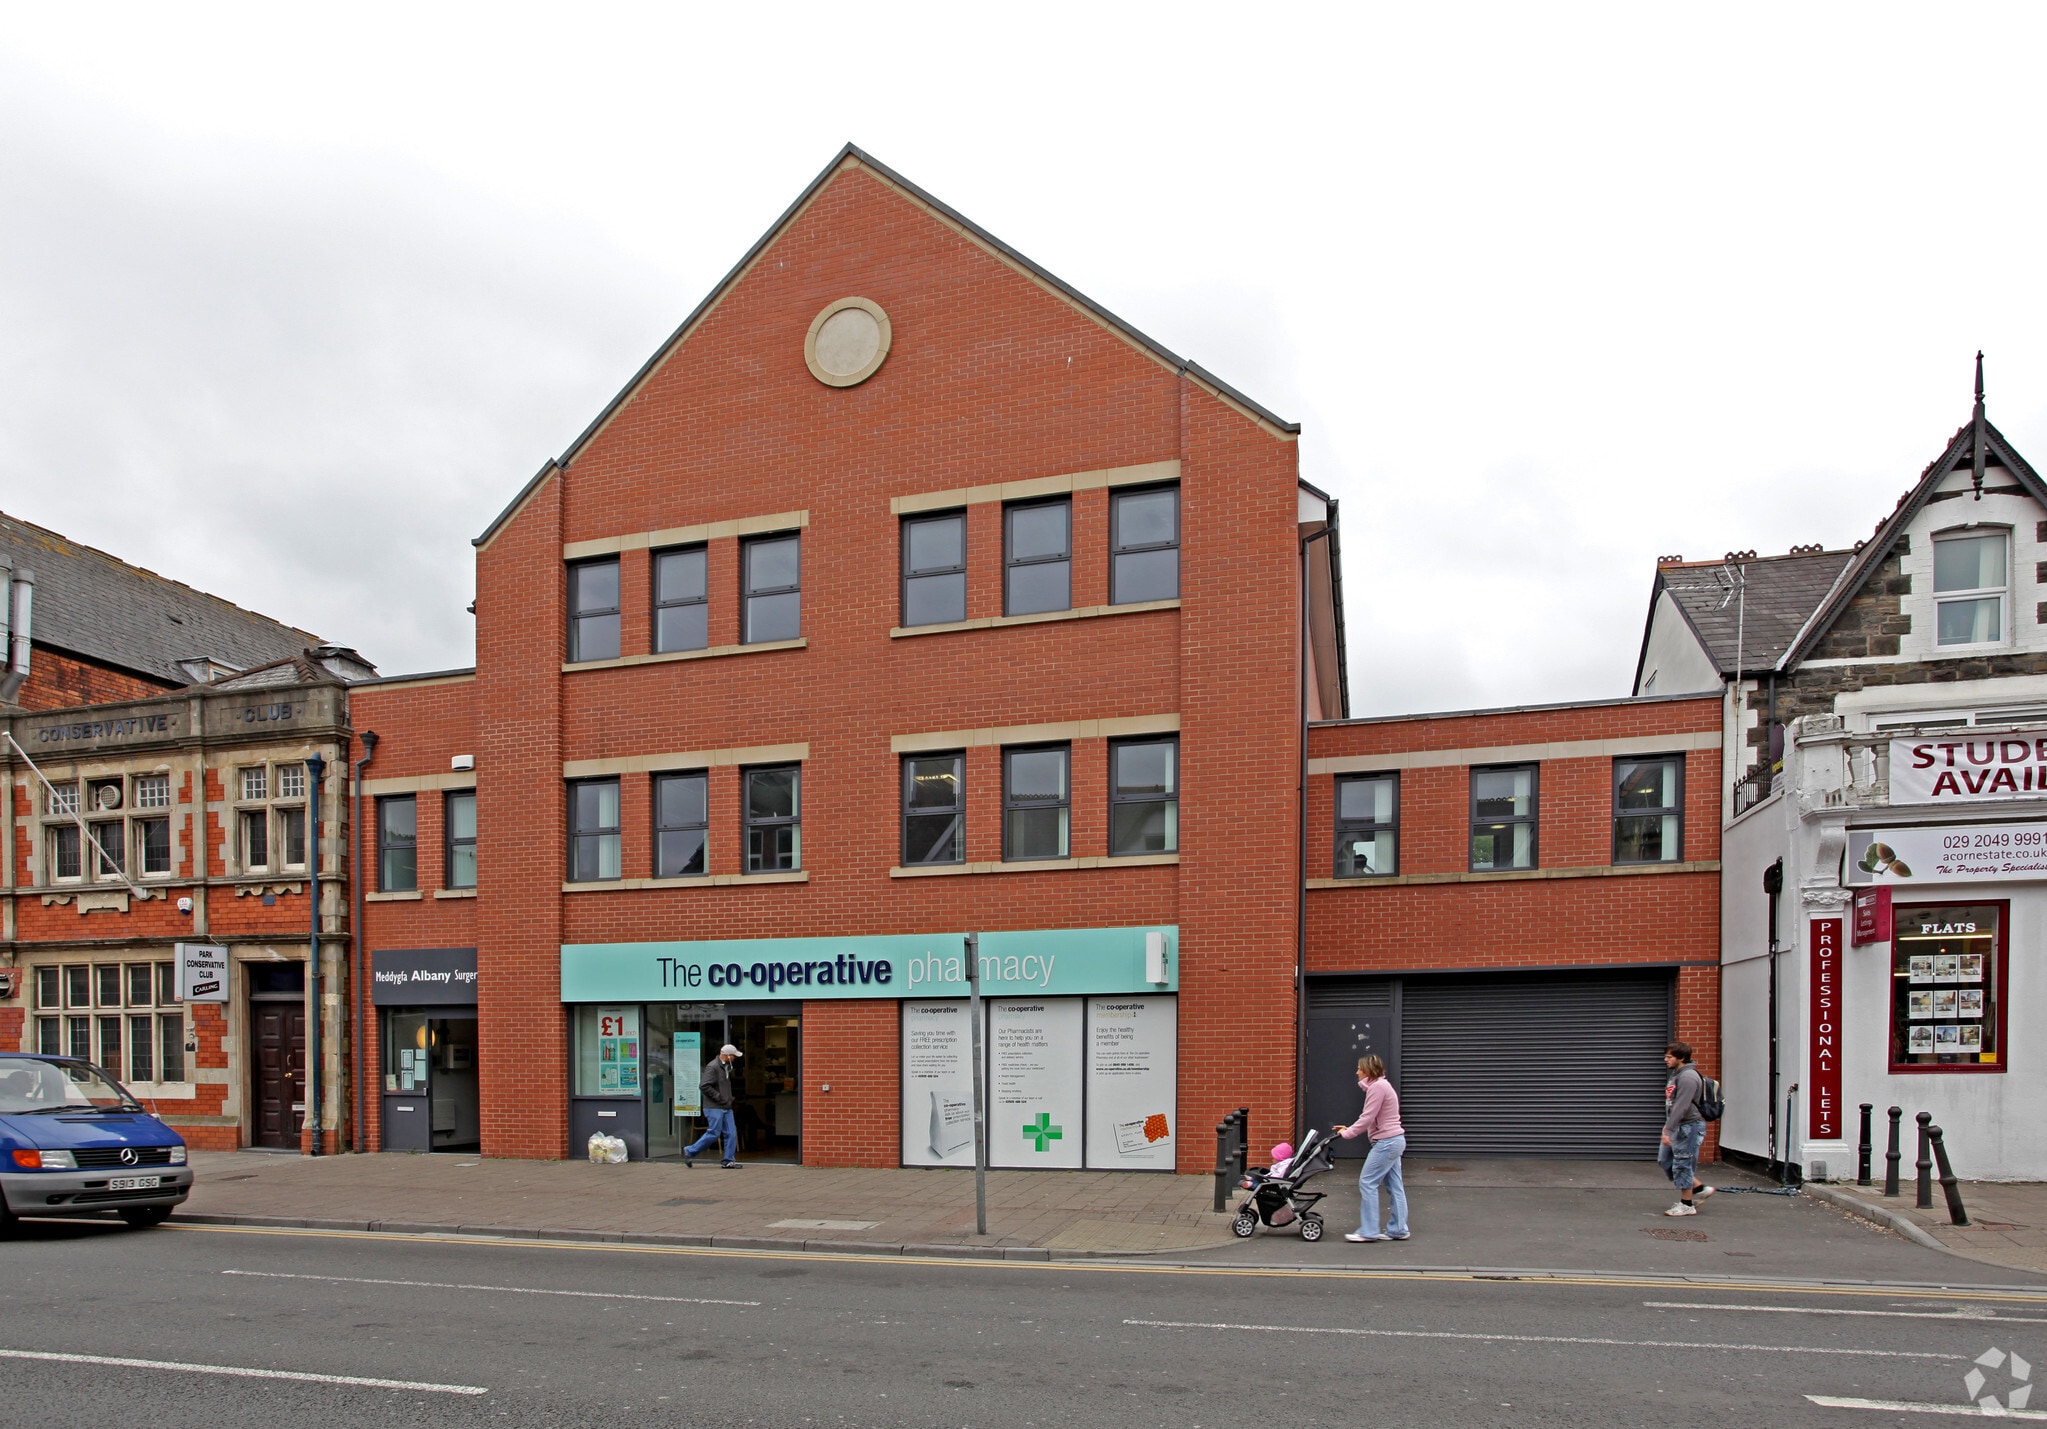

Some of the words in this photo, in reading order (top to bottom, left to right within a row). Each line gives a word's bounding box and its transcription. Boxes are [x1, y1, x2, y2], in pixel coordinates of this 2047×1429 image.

[40, 716, 168, 742] CONSERVATIVE
[243, 705, 292, 722] CLUB
[1944, 835, 1970, 848] 029
[1974, 834, 2010, 848] 2049
[1943, 848, 2047, 861] acornestate.co.uk
[1936, 865, 1952, 874] The
[1956, 864, 1998, 874] Property
[1921, 922, 1976, 934] FLATS
[186, 960, 224, 969] CONSERVATIVE
[376, 971, 408, 984] Meddygfa
[411, 970, 451, 983] Albany
[656, 958, 702, 987] The
[708, 953, 892, 993] co-operative
[1819, 922, 1832, 1070] PROFESSIONAL
[601, 1016, 623, 1036] £1
[1820, 1086, 1830, 1134] LETS
[112, 1180, 135, 1188] S913
[139, 1178, 157, 1187] GSG
